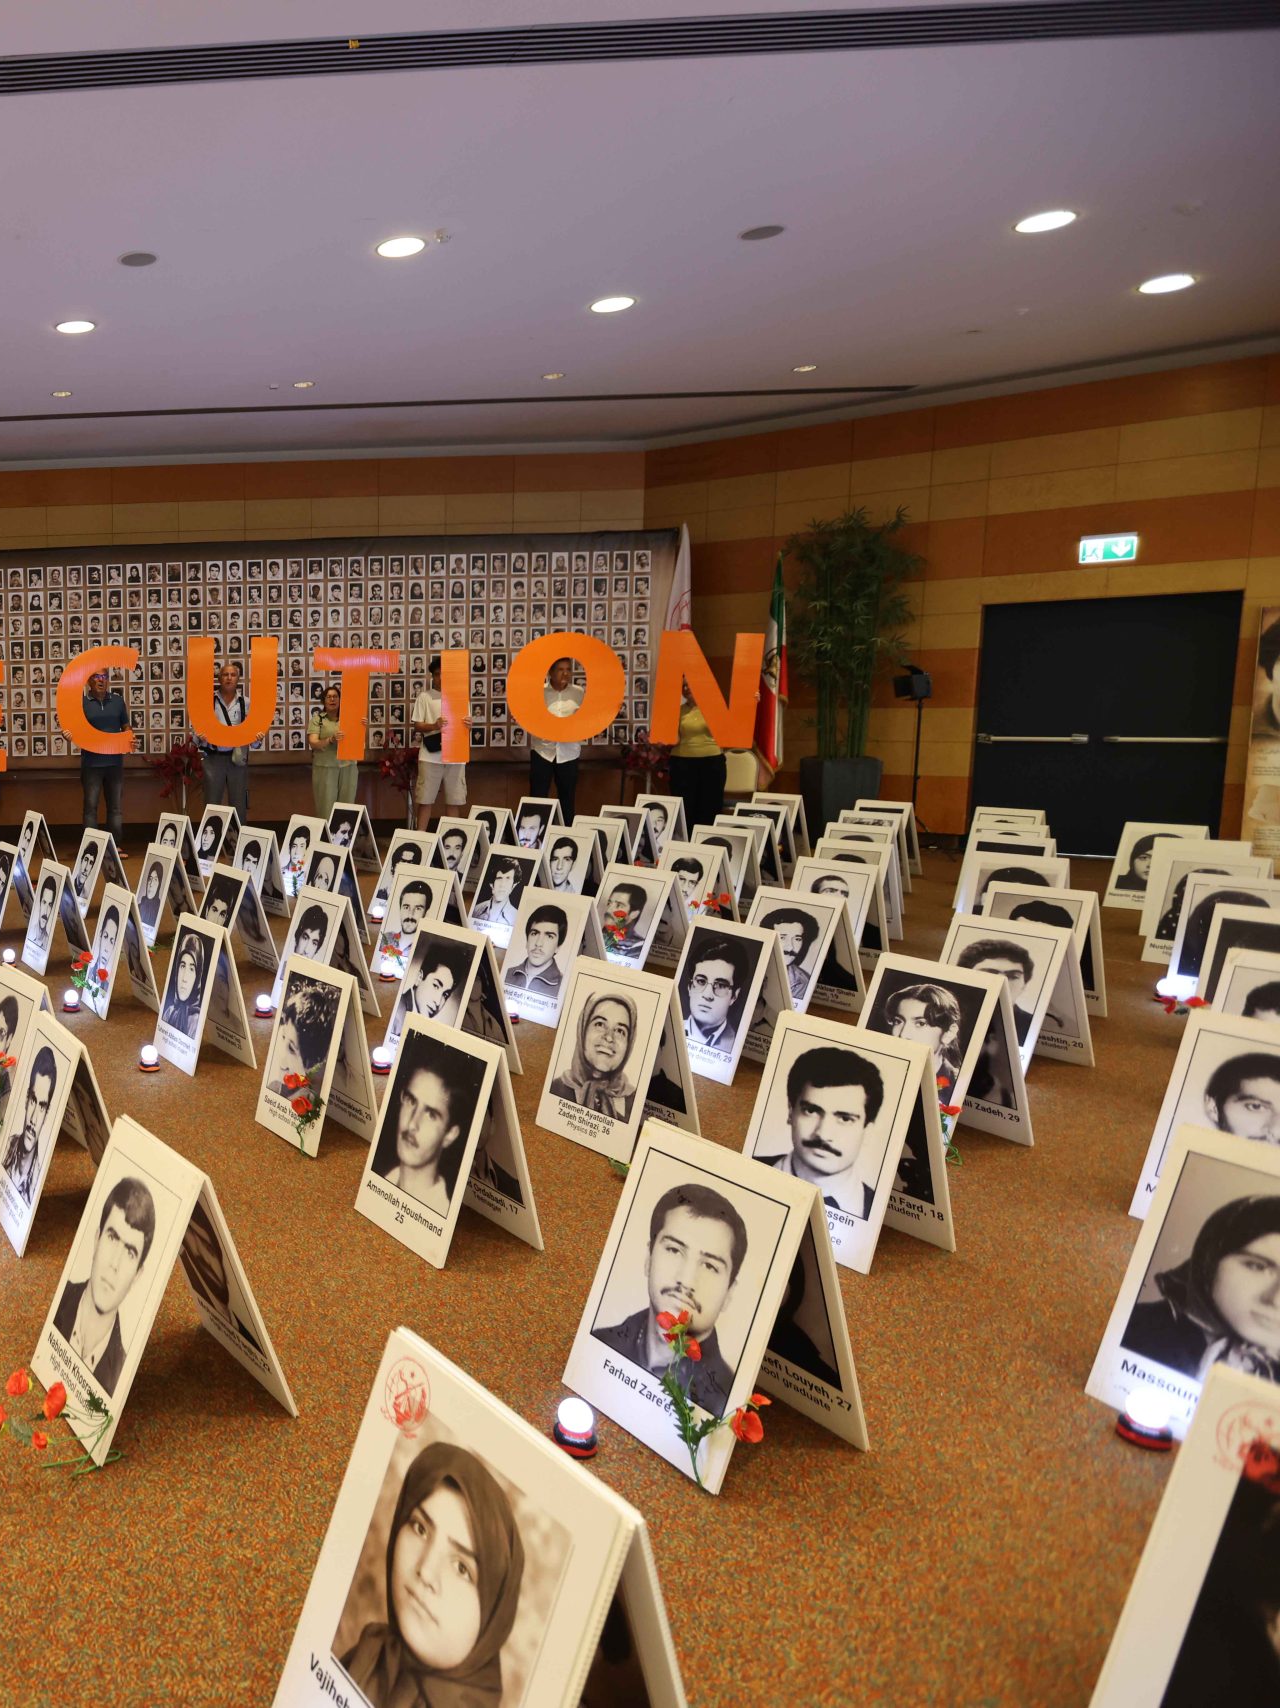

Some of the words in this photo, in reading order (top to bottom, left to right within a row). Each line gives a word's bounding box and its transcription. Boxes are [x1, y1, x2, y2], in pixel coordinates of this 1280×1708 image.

[558, 1108, 577, 1120] Zadeh
[578, 1116, 601, 1133] Shirazi,
[601, 1127, 610, 1136] 36
[559, 1099, 586, 1115] Fatemeh
[585, 1110, 615, 1128] Ayatollah
[974, 1102, 1006, 1119] Zadeh,
[1007, 1113, 1020, 1122] 29
[567, 1120, 588, 1134] Physics
[366, 1179, 401, 1209] Amanollah
[400, 1202, 444, 1237] Houshmand
[474, 1191, 502, 1214] Teenager
[509, 1204, 519, 1215] 17
[899, 1196, 927, 1217] Fard,
[929, 1209, 944, 1222] 18
[394, 1211, 405, 1225] 25
[824, 1210, 855, 1228] ssein
[47, 1331, 73, 1370] Nabiollah
[49, 1353, 61, 1373] High
[59, 1369, 77, 1393] school
[603, 1358, 639, 1390] Farhad
[782, 1377, 832, 1412] graduate
[785, 1366, 834, 1404] Louyeh,
[834, 1396, 853, 1412] 27
